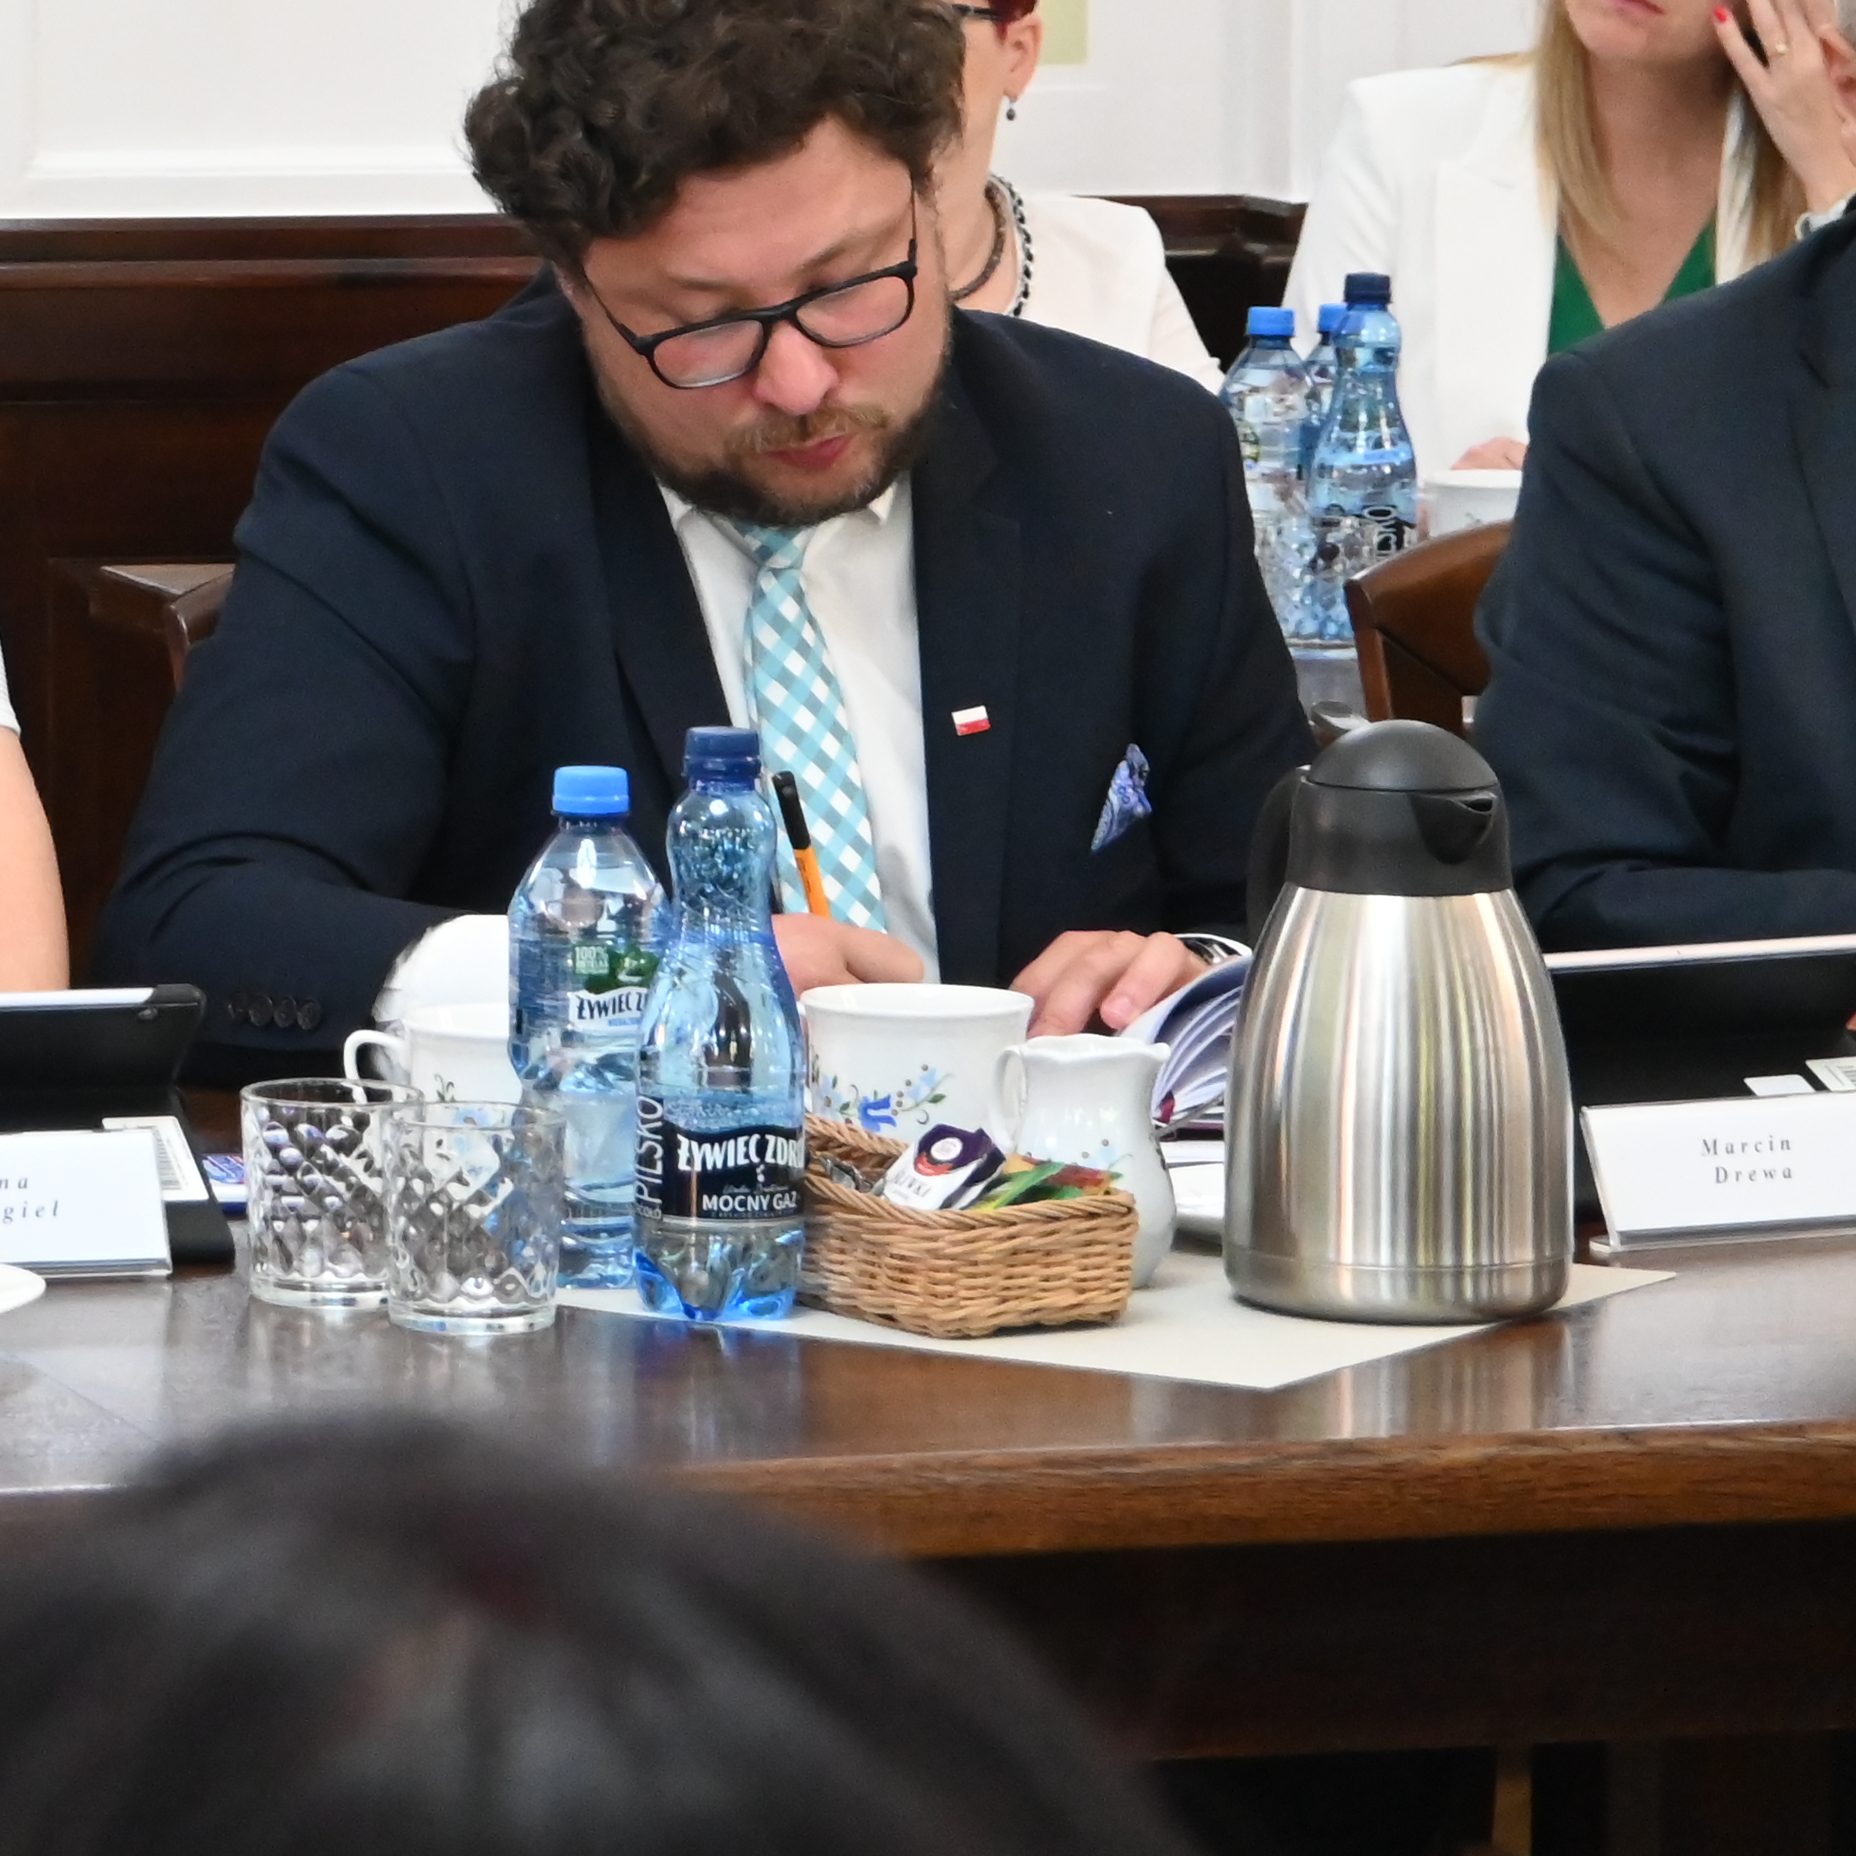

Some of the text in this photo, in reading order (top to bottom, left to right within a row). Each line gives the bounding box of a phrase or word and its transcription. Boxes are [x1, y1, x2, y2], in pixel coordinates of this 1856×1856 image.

[635, 1095, 664, 1205] PILSKO
[676, 1133, 762, 1172] ŻYWIEC
[1701, 1134, 1791, 1157] Marcin
[1714, 1166, 1793, 1184] Drewa
[702, 1191, 798, 1212] MOCNY GAZ
